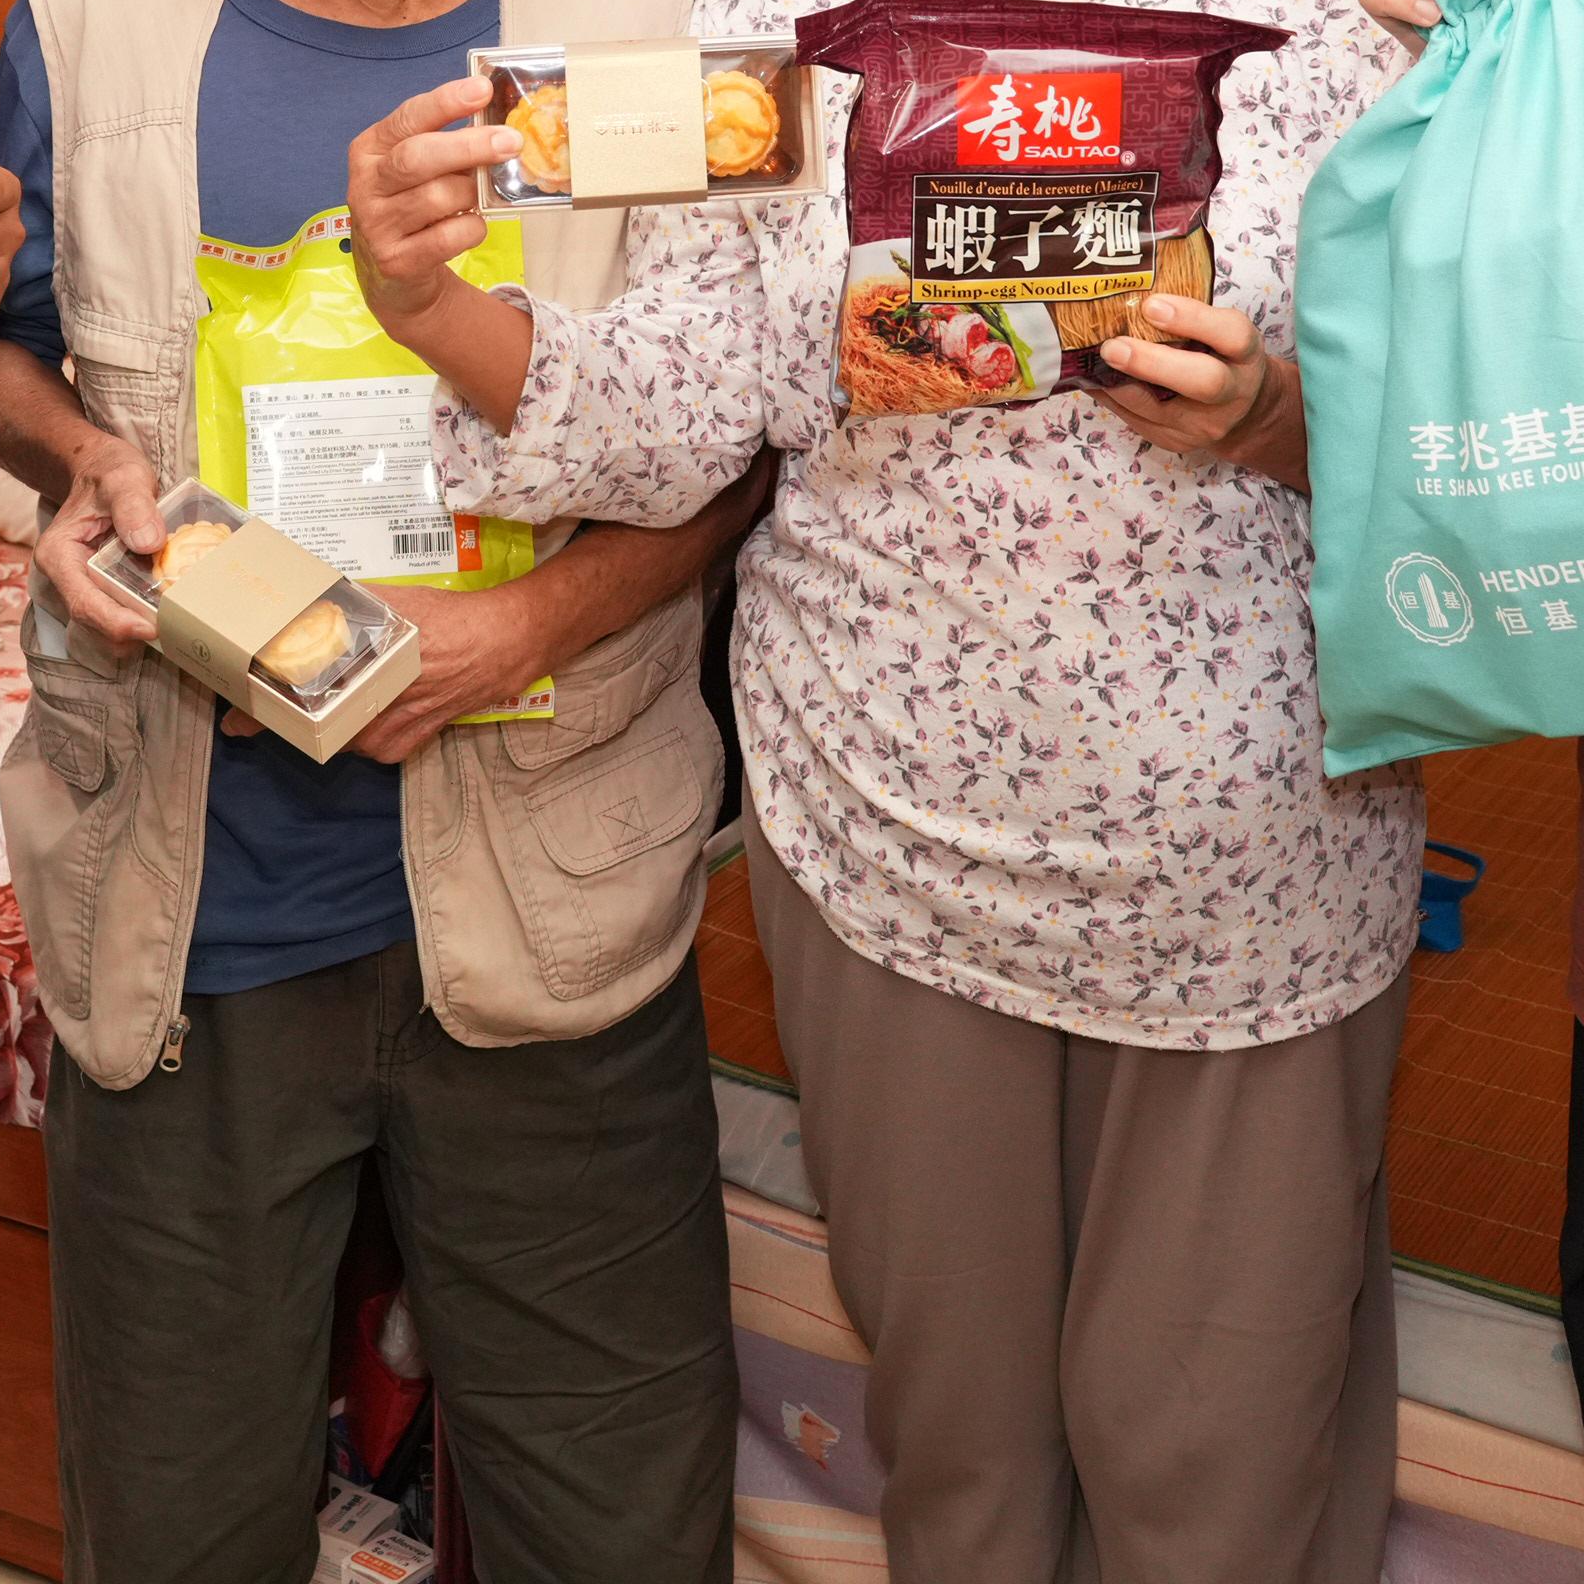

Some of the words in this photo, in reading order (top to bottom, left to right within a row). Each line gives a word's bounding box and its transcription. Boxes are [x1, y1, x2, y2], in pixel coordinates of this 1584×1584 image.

[1024, 145, 1121, 159] SAUTAO
[929, 180, 973, 195] Nouille
[1016, 182, 1030, 196] de
[1032, 182, 1044, 196] la
[1045, 183, 1093, 196] crevette
[1094, 178, 1144, 195] (Maigre)
[924, 197, 1144, 276] 蝦子麵
[921, 284, 1017, 300] Shrimp-egg
[1020, 279, 1089, 296] Noodles
[1093, 276, 1145, 291] (Thin)
[1416, 477, 1443, 496] LEE
[1449, 477, 1491, 497] SHAU
[1498, 470, 1536, 493] KEE
[459, 529, 476, 550] 湯
